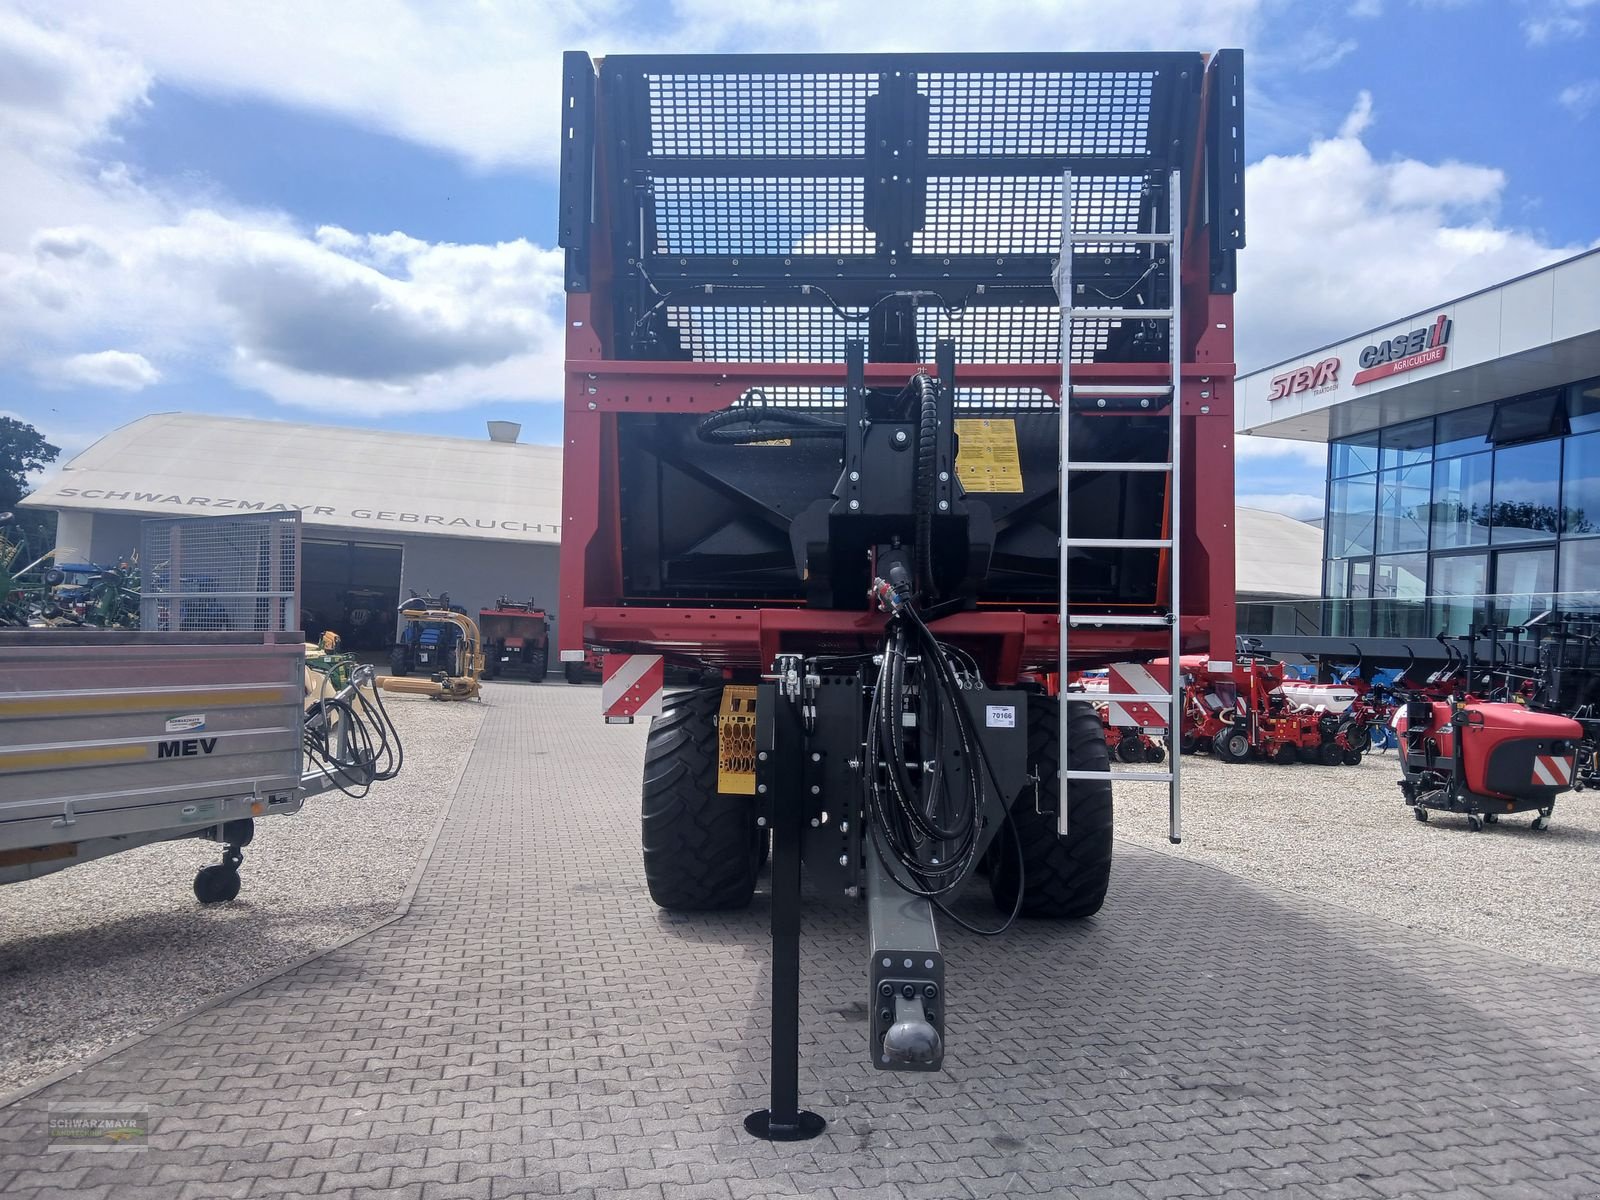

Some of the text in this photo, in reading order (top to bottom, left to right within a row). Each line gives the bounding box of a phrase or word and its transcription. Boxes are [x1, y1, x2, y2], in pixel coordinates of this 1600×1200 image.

[1358, 327, 1427, 369] CASE
[1393, 349, 1441, 372] AGRICULTURE
[1267, 357, 1341, 401] STEYR
[56, 488, 562, 534] SCHWARZMAYR GEBRAUCHT
[157, 737, 218, 759] MEV
